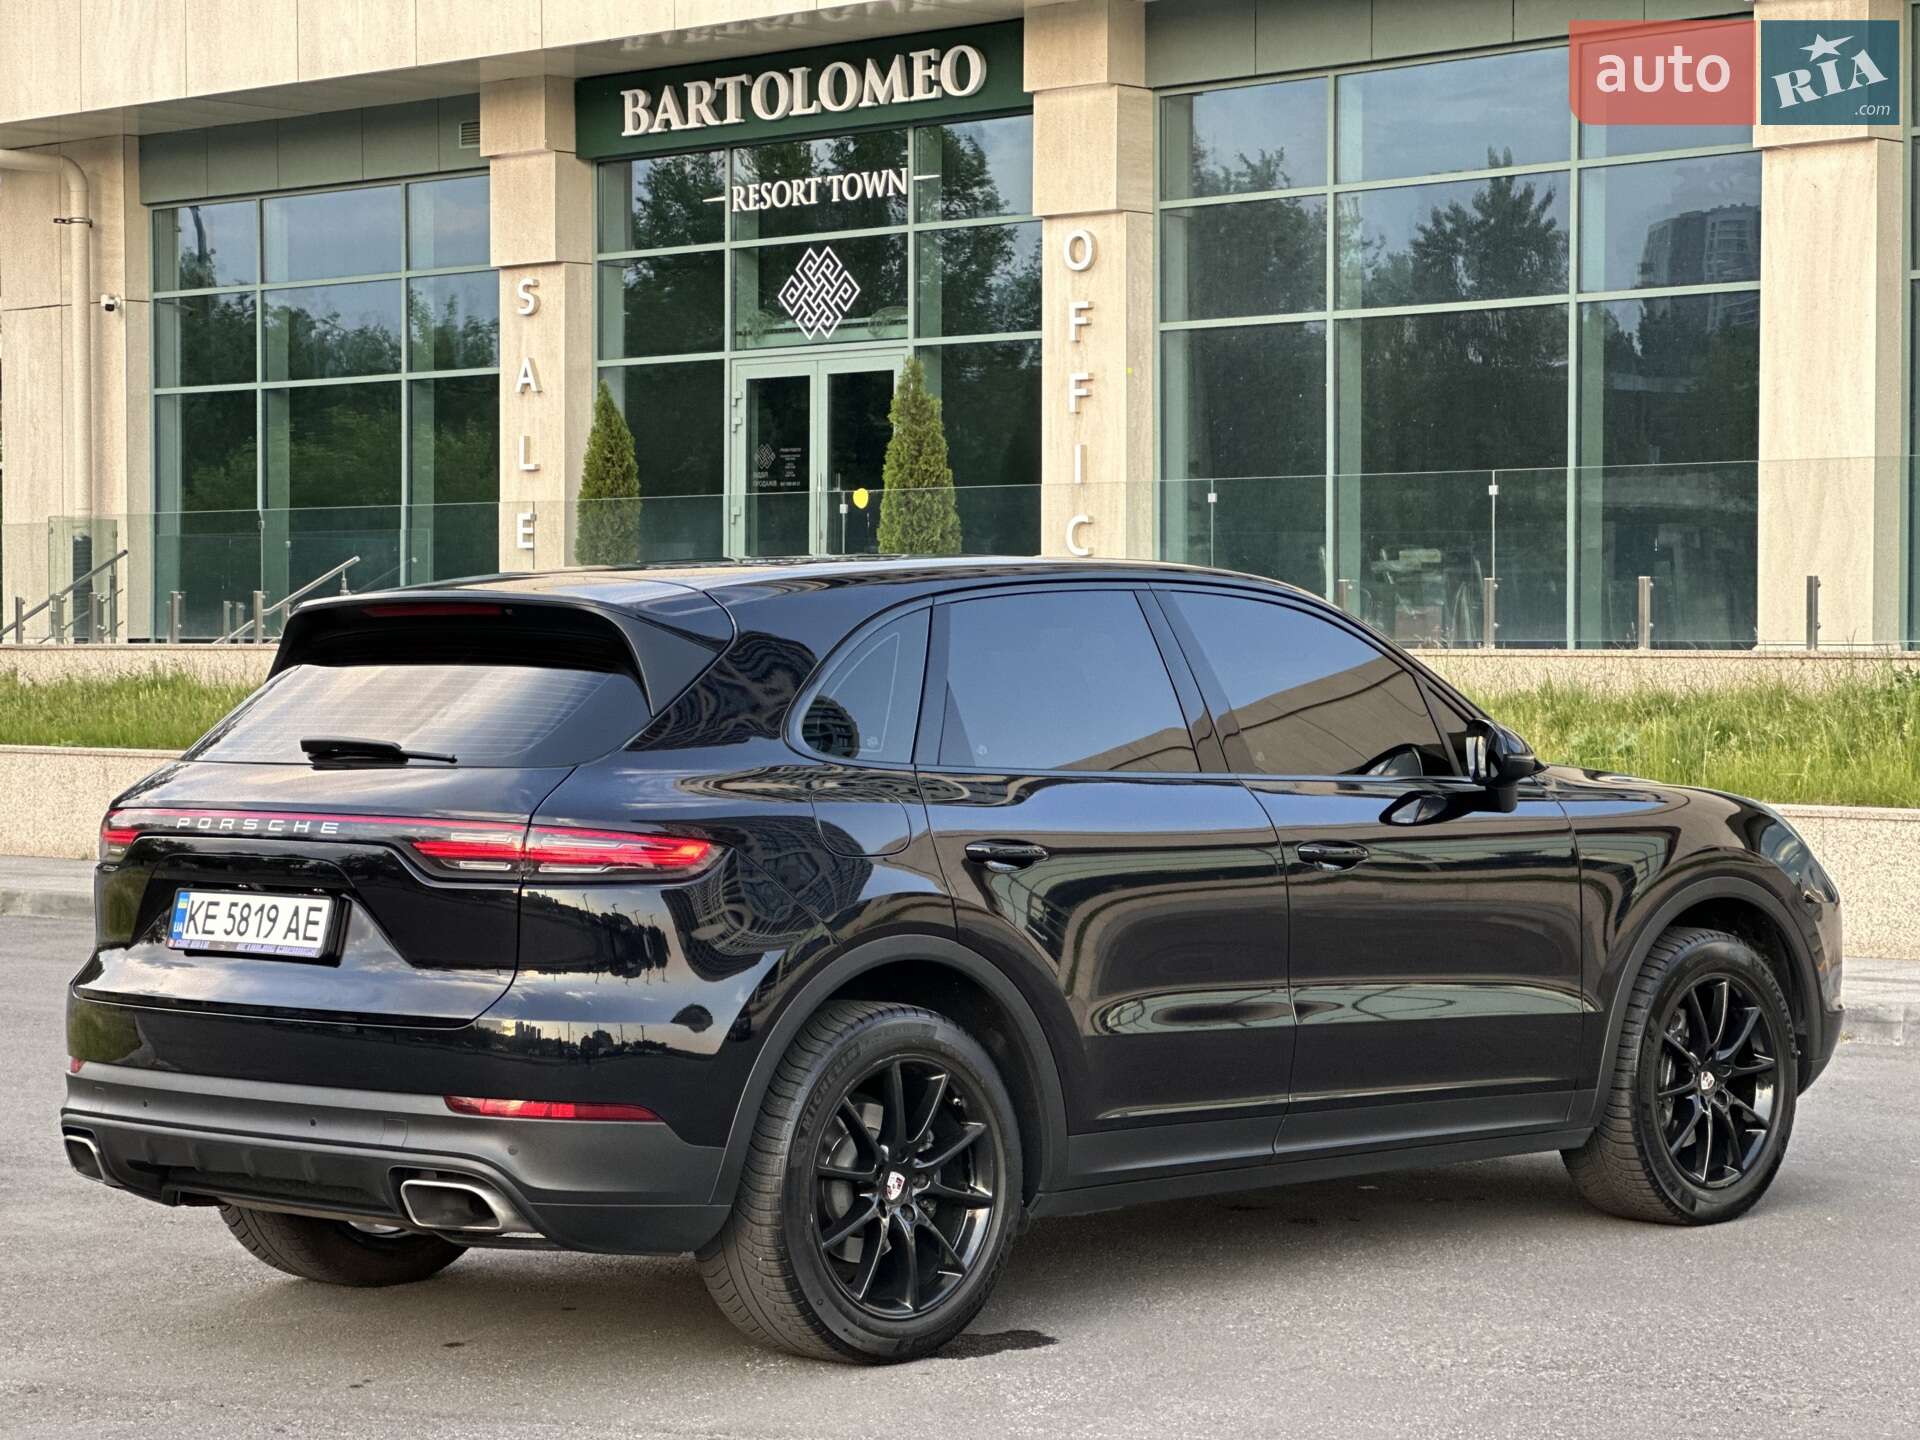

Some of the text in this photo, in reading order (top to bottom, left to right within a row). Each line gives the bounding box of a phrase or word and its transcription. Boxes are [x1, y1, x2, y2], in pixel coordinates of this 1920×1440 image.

[620, 44, 987, 137] BARTOLOMEO
[731, 168, 908, 212] RESORT TOWN
[515, 278, 543, 550] SALE
[176, 817, 339, 834] PORSCHE
[173, 921, 184, 933] UA
[185, 900, 323, 942] KE 5819 AE
